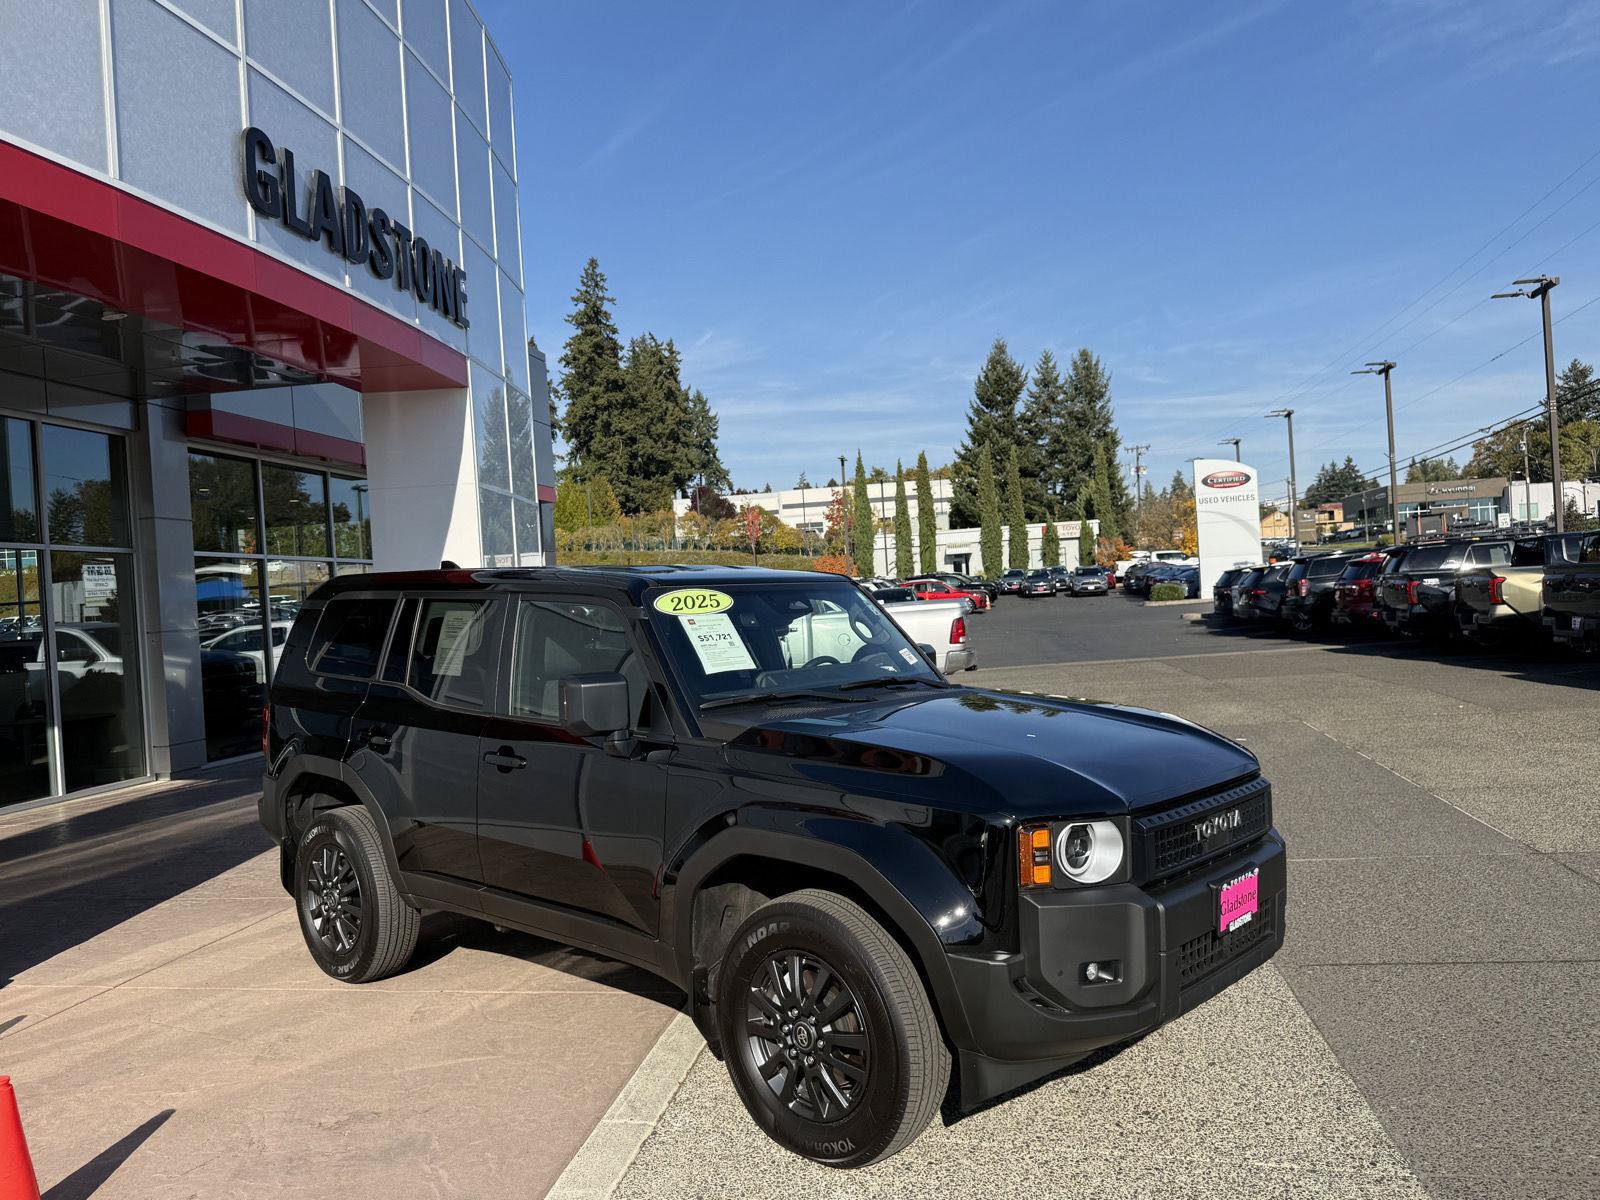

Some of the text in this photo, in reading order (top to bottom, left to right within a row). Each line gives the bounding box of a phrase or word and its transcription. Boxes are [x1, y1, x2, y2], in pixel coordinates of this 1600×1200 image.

[241, 126, 470, 330] GLADSTONE
[1207, 476, 1245, 484] CERTIFIED
[1220, 494, 1255, 502] VEHICLES
[670, 594, 720, 611] 2025
[698, 633, 733, 642] $51,721
[1195, 810, 1241, 842] TOYOTA
[1220, 889, 1257, 916] Gladstone
